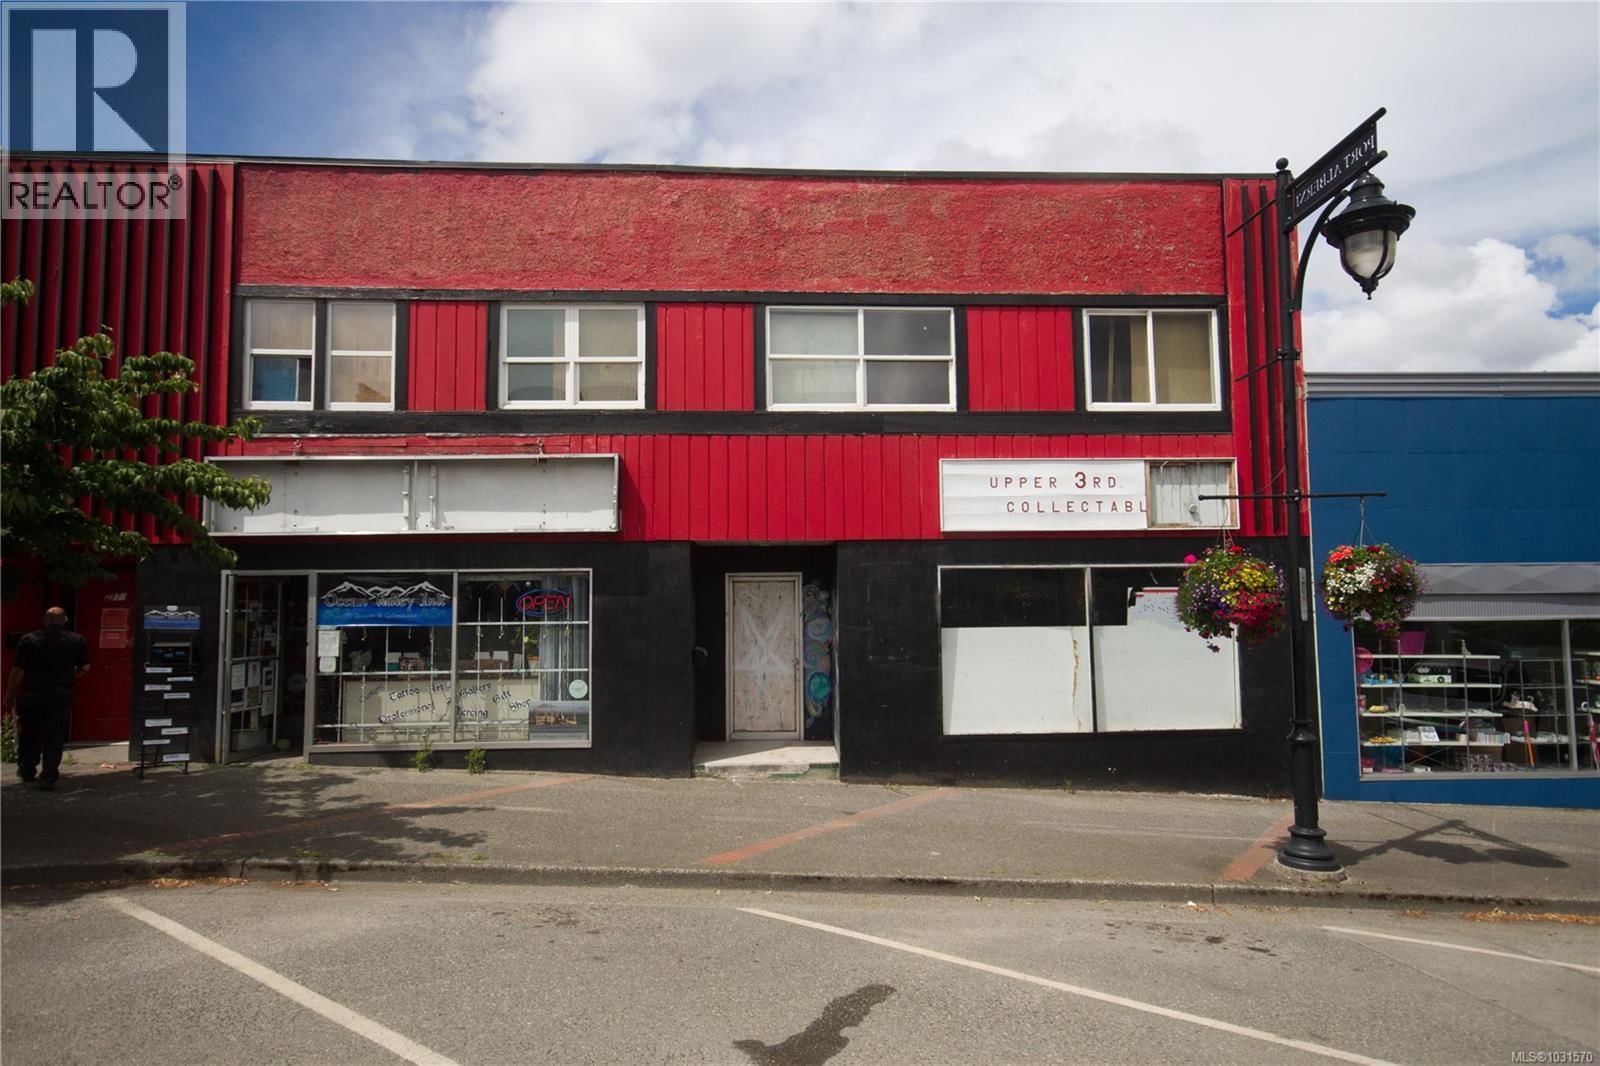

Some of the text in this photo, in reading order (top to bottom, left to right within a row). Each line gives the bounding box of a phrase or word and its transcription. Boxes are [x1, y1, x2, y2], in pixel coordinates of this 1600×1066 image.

[989, 476, 1058, 489] UPPER
[323, 593, 447, 612] Ocean Valley Ink
[518, 594, 573, 611] OPEN
[458, 681, 492, 698] Gallery
[492, 689, 513, 704] Gift
